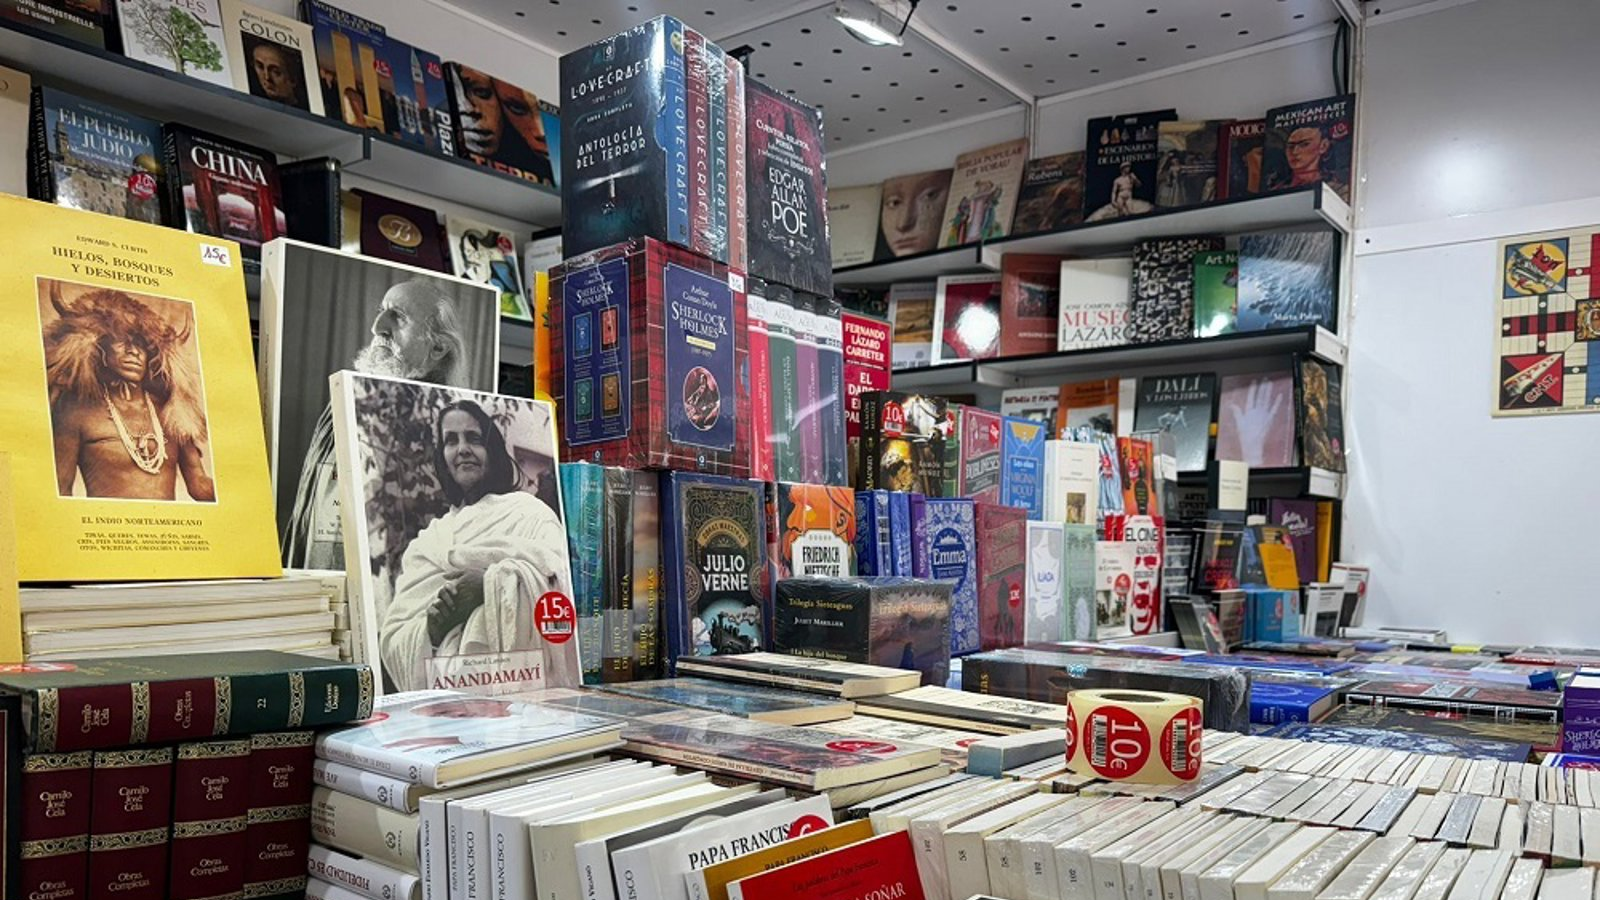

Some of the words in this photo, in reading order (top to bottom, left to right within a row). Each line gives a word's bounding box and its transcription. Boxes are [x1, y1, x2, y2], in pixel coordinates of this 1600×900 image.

[1274, 106, 1315, 123] MEXICAN
[1319, 101, 1346, 114] ART
[85, 113, 151, 149] PUEBLO
[436, 110, 454, 157] Plaz
[1230, 124, 1265, 137] MODIG
[601, 138, 646, 161] TERROR
[191, 146, 267, 186] CHINA
[769, 167, 806, 195] EDGAR
[771, 185, 808, 210] ALLAN
[772, 201, 808, 239] POE
[52, 246, 108, 266] HIELOS,
[113, 256, 174, 277] BOSQUES
[1205, 255, 1222, 265] Art
[1226, 254, 1238, 264] N
[71, 264, 80, 274] Y
[85, 265, 160, 287] DESIERTOS
[672, 301, 728, 336] SHERLOCK
[680, 317, 720, 339] HOLMES
[845, 322, 885, 341] FERNANDO
[846, 346, 885, 362] CARRETER
[860, 372, 872, 385] EL
[1156, 375, 1201, 393] DALÍ
[886, 407, 903, 423] 10€
[1125, 528, 1137, 542] EL
[703, 554, 745, 572] JULIO
[802, 546, 840, 564] FRIEDRICH
[932, 548, 966, 566] Emma
[702, 574, 749, 592] VERNE
[540, 597, 571, 620] 15€
[432, 664, 541, 690] ANANDAMAYÍ
[258, 698, 267, 710] 22
[1110, 719, 1143, 771] 10€
[268, 764, 295, 775] Camilo
[201, 776, 229, 787] Camilo
[273, 779, 289, 788] Cela
[40, 791, 72, 802] Camilo
[119, 786, 150, 797] Camilo
[206, 792, 224, 801] Cela
[46, 808, 66, 818] Cela
[124, 802, 143, 812] Cela
[688, 849, 729, 871] PAPA
[731, 824, 796, 857] FRANCIS
[466, 830, 477, 899] FRANCISCO
[40, 880, 67, 892] Obras
